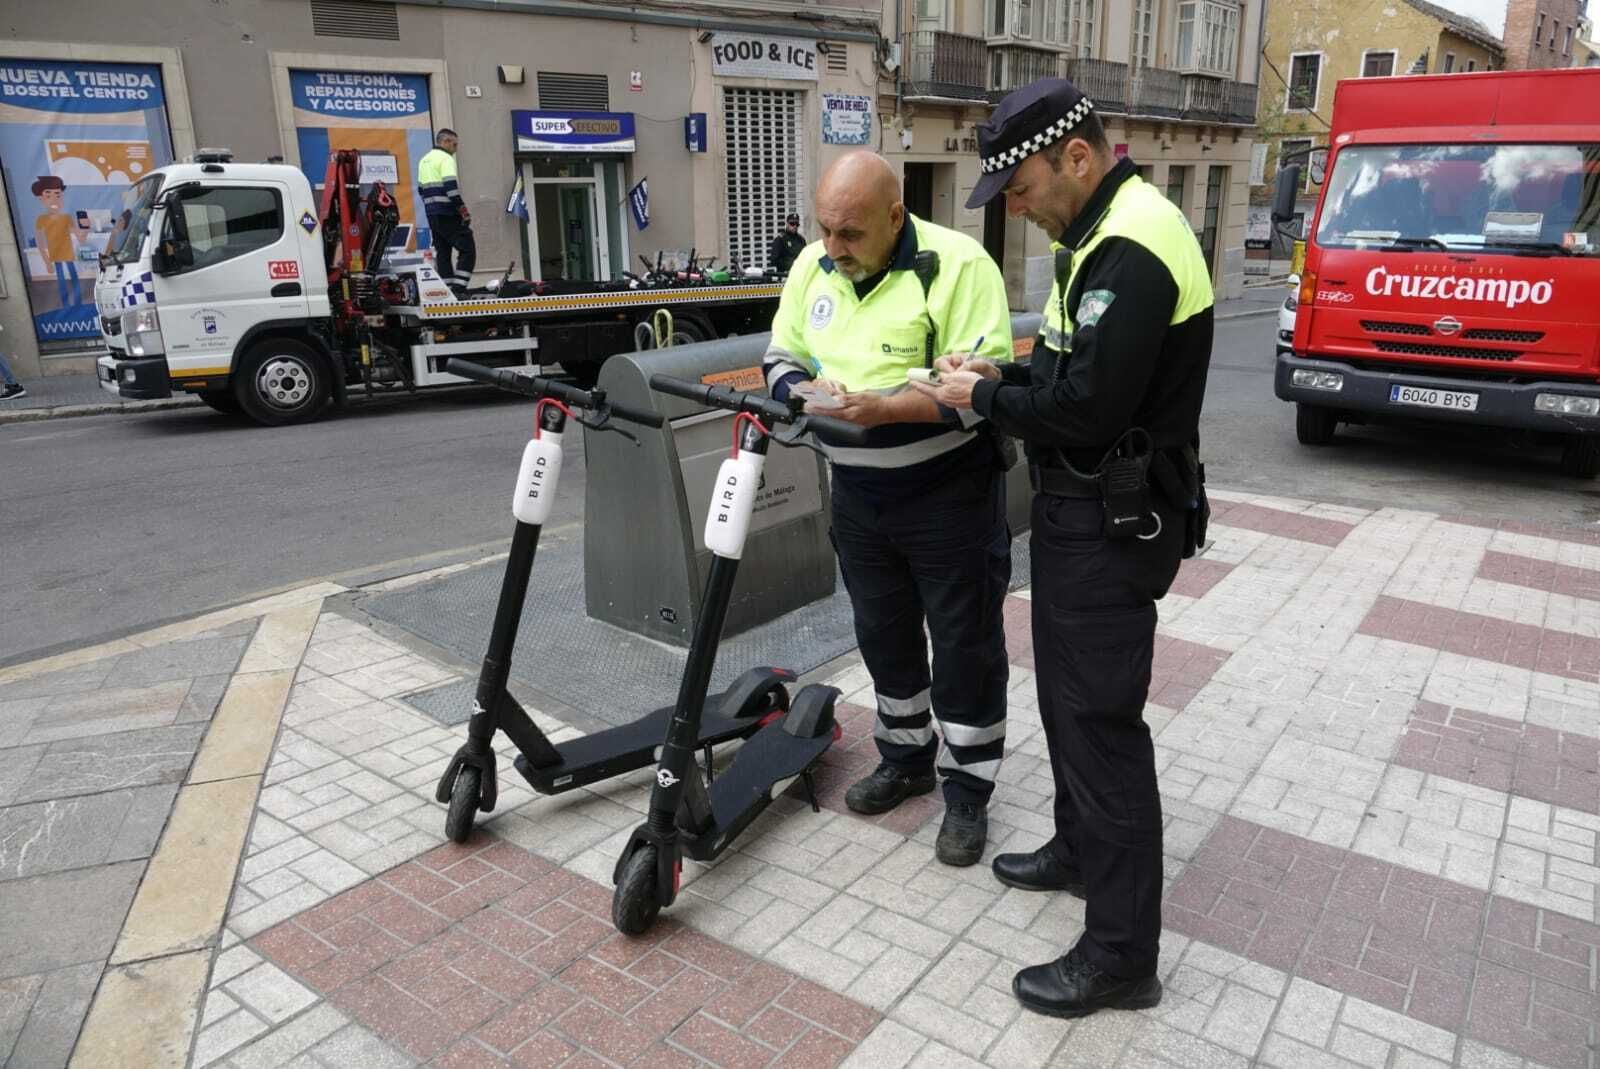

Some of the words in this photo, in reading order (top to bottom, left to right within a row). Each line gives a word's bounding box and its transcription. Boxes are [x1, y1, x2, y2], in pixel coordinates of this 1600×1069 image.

[714, 41, 763, 65] FOOD
[768, 42, 781, 62] &
[787, 45, 815, 70] ICE
[0, 67, 71, 85] NUEVA
[75, 71, 156, 88] TIENDA
[4, 84, 81, 98] BOSSTEL
[83, 87, 149, 100] CENTRO
[304, 85, 417, 100] REPARACIONES
[309, 98, 320, 110] Y
[324, 98, 416, 112] ACCESORIOS
[827, 99, 844, 110] VENTA
[845, 100, 852, 111] DE
[853, 100, 868, 112] HIELO
[535, 121, 567, 132] SUPER
[945, 137, 959, 152] LA
[962, 137, 977, 152] TR
[279, 262, 298, 274] 112
[1365, 264, 1553, 308] Cruzcampo
[1402, 388, 1438, 404] 6040
[1443, 392, 1472, 408] BYS
[528, 456, 546, 498] BIRD
[718, 475, 737, 522] BIRD
